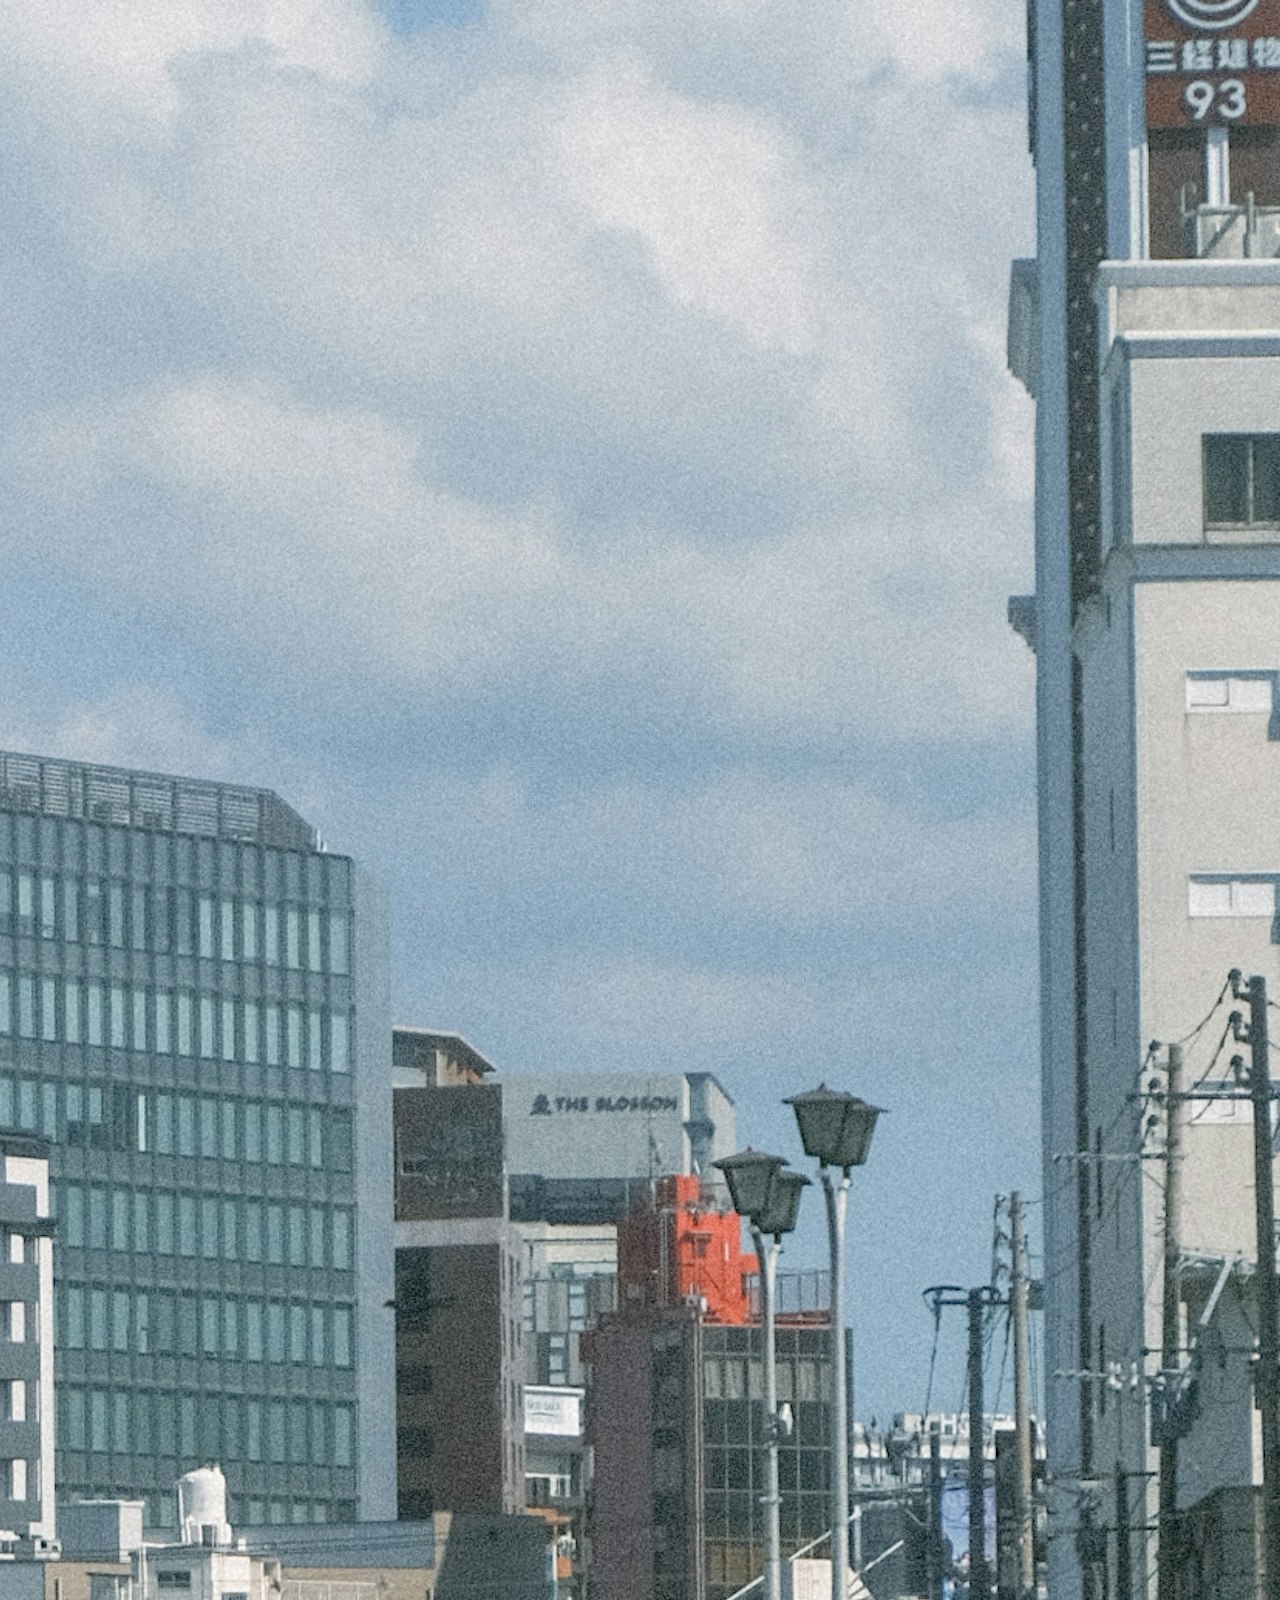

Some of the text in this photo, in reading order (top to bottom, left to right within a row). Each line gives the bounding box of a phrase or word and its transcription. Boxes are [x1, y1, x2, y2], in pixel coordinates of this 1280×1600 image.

[1186, 79, 1246, 119] 93
[554, 1096, 678, 1113] THE BLOSSOM
